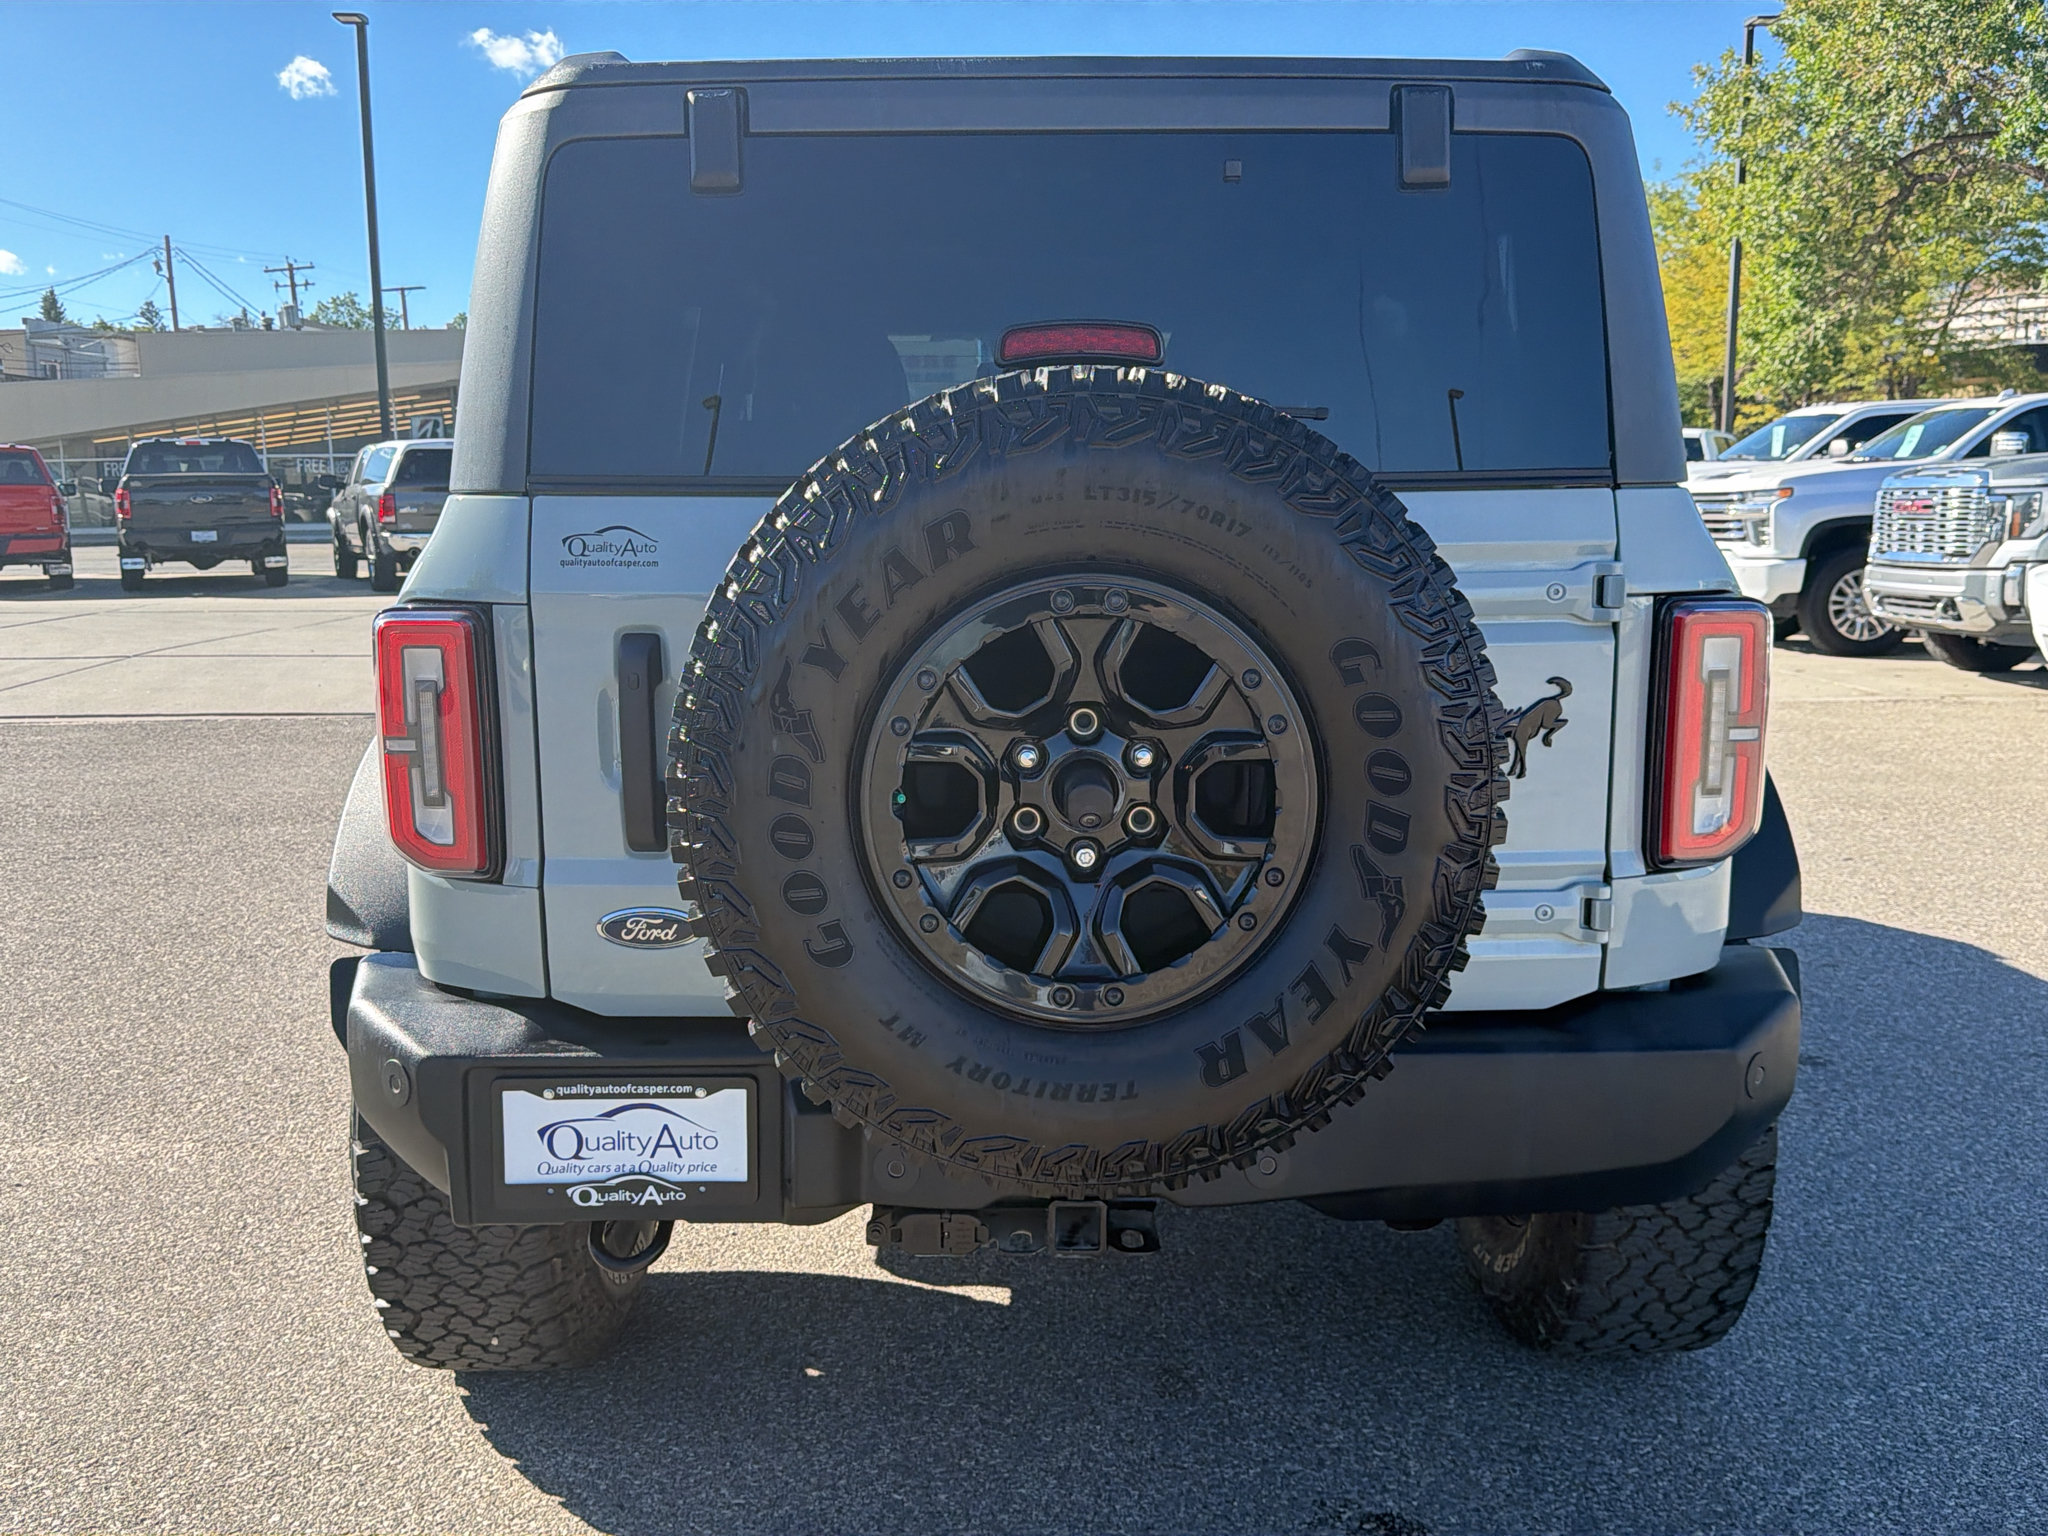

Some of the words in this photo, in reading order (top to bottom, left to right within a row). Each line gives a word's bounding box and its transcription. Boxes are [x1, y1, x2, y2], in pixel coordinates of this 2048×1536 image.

[296, 458, 327, 473] FREE
[560, 557, 659, 569] qualityautoofcasper.com
[621, 917, 678, 941] Ford
[878, 1012, 929, 1049] MT
[945, 1055, 1139, 1103] TERRITORY
[555, 1083, 693, 1097] qualityautoofcasper.com
[537, 1160, 585, 1176] Quality
[587, 1163, 611, 1174] cars
[614, 1163, 628, 1174] at
[629, 1165, 636, 1174] a
[638, 1159, 685, 1175] Quality
[687, 1161, 718, 1174] price
